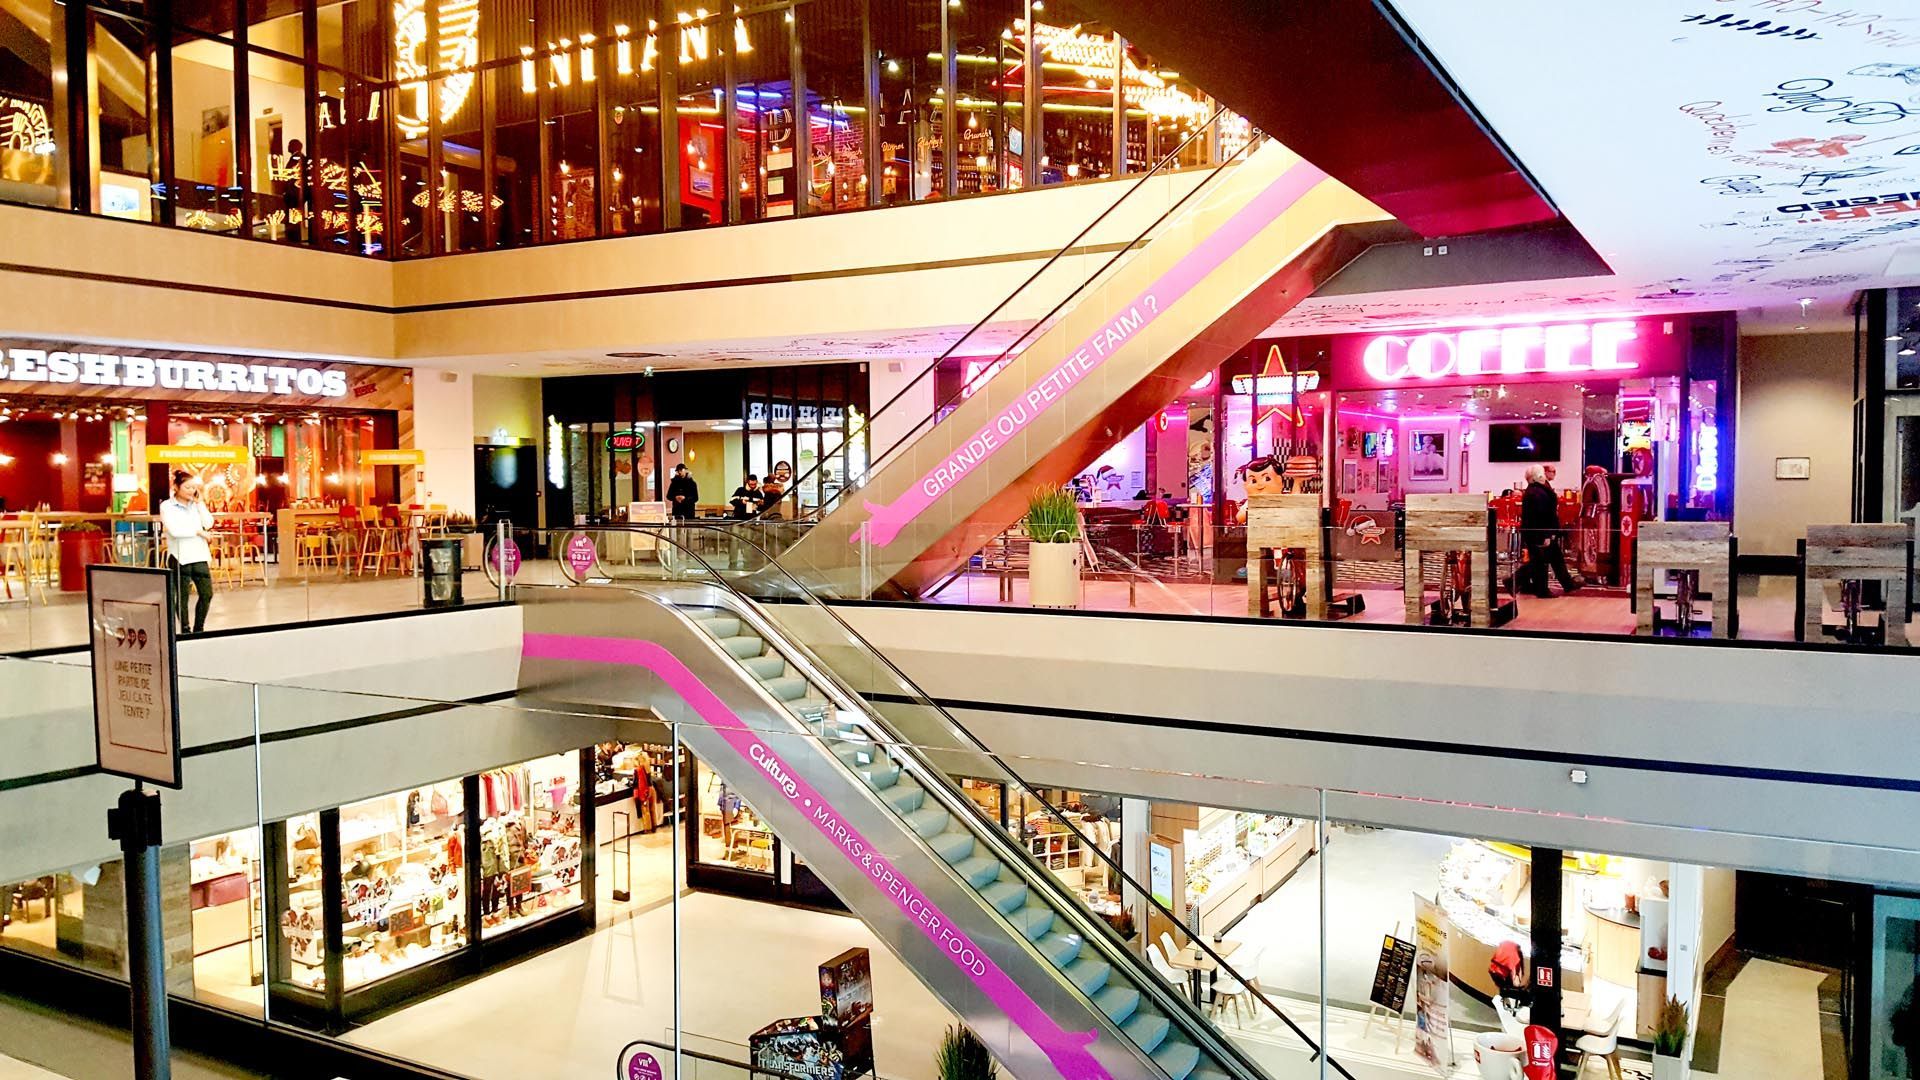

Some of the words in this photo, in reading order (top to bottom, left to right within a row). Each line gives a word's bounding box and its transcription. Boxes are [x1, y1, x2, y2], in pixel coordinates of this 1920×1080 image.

[1362, 320, 1639, 382] COFFEE
[0, 348, 347, 397] ESHBURRITOS
[922, 429, 999, 498] GRANDE
[996, 402, 1028, 436] OU
[1026, 346, 1095, 412] PETITE
[1091, 307, 1145, 357] FAIM
[1143, 294, 1159, 315] ?
[612, 435, 642, 447] UVET
[114, 660, 129, 673] UNE
[130, 661, 152, 675] PETITE
[118, 675, 140, 689] PARTIE
[141, 678, 151, 690] DE
[123, 704, 144, 719] TENTE
[749, 743, 800, 799] Cultura
[813, 805, 864, 857] MARKS
[871, 862, 941, 935] SPENCER
[938, 927, 987, 978] FOOD
